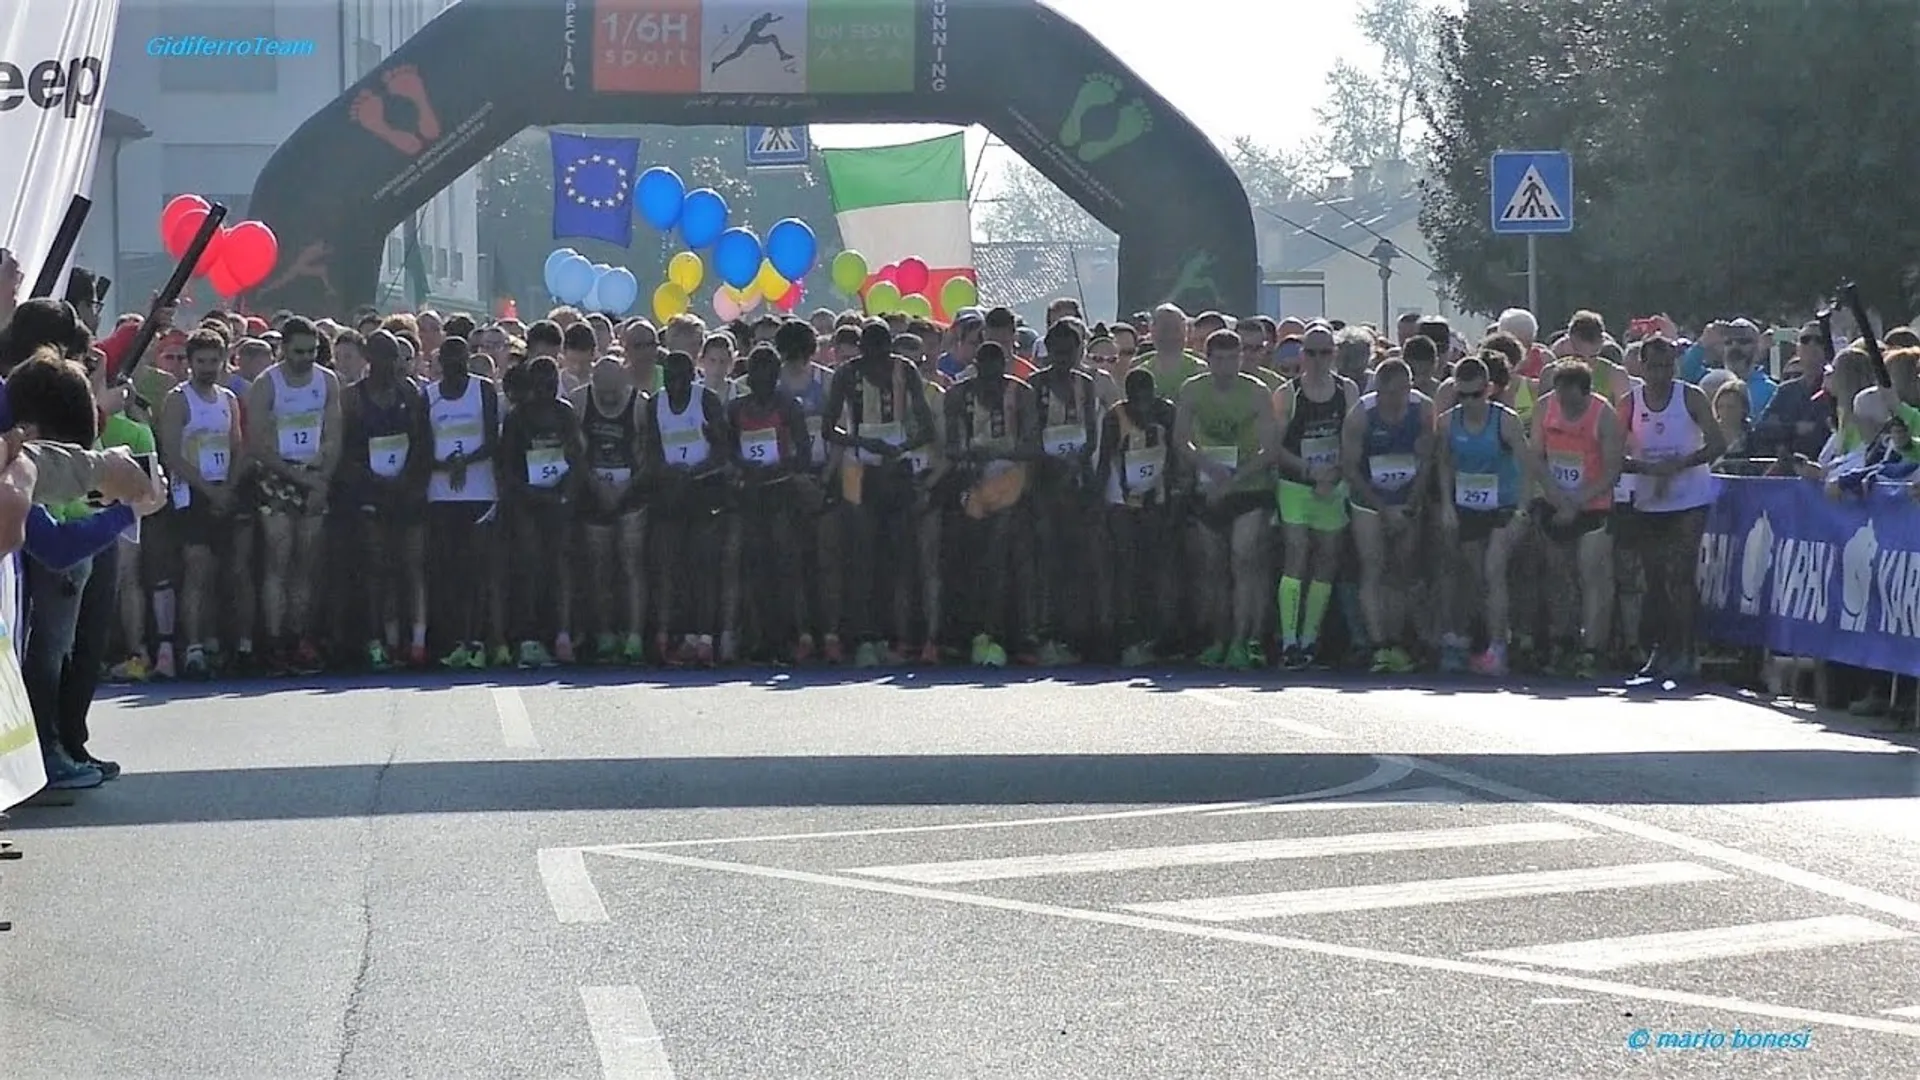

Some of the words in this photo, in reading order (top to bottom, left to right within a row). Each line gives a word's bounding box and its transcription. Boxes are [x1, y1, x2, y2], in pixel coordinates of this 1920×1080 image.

[602, 12, 688, 45] 1/6H
[563, 0, 576, 91] PECIAL
[932, 0, 948, 92] UNNING
[605, 50, 688, 68] sport
[293, 432, 308, 445] 12
[679, 446, 687, 460] 7
[750, 444, 765, 458] 55
[214, 453, 225, 465] 11
[542, 465, 559, 479] 54
[1464, 490, 1489, 504] 297
